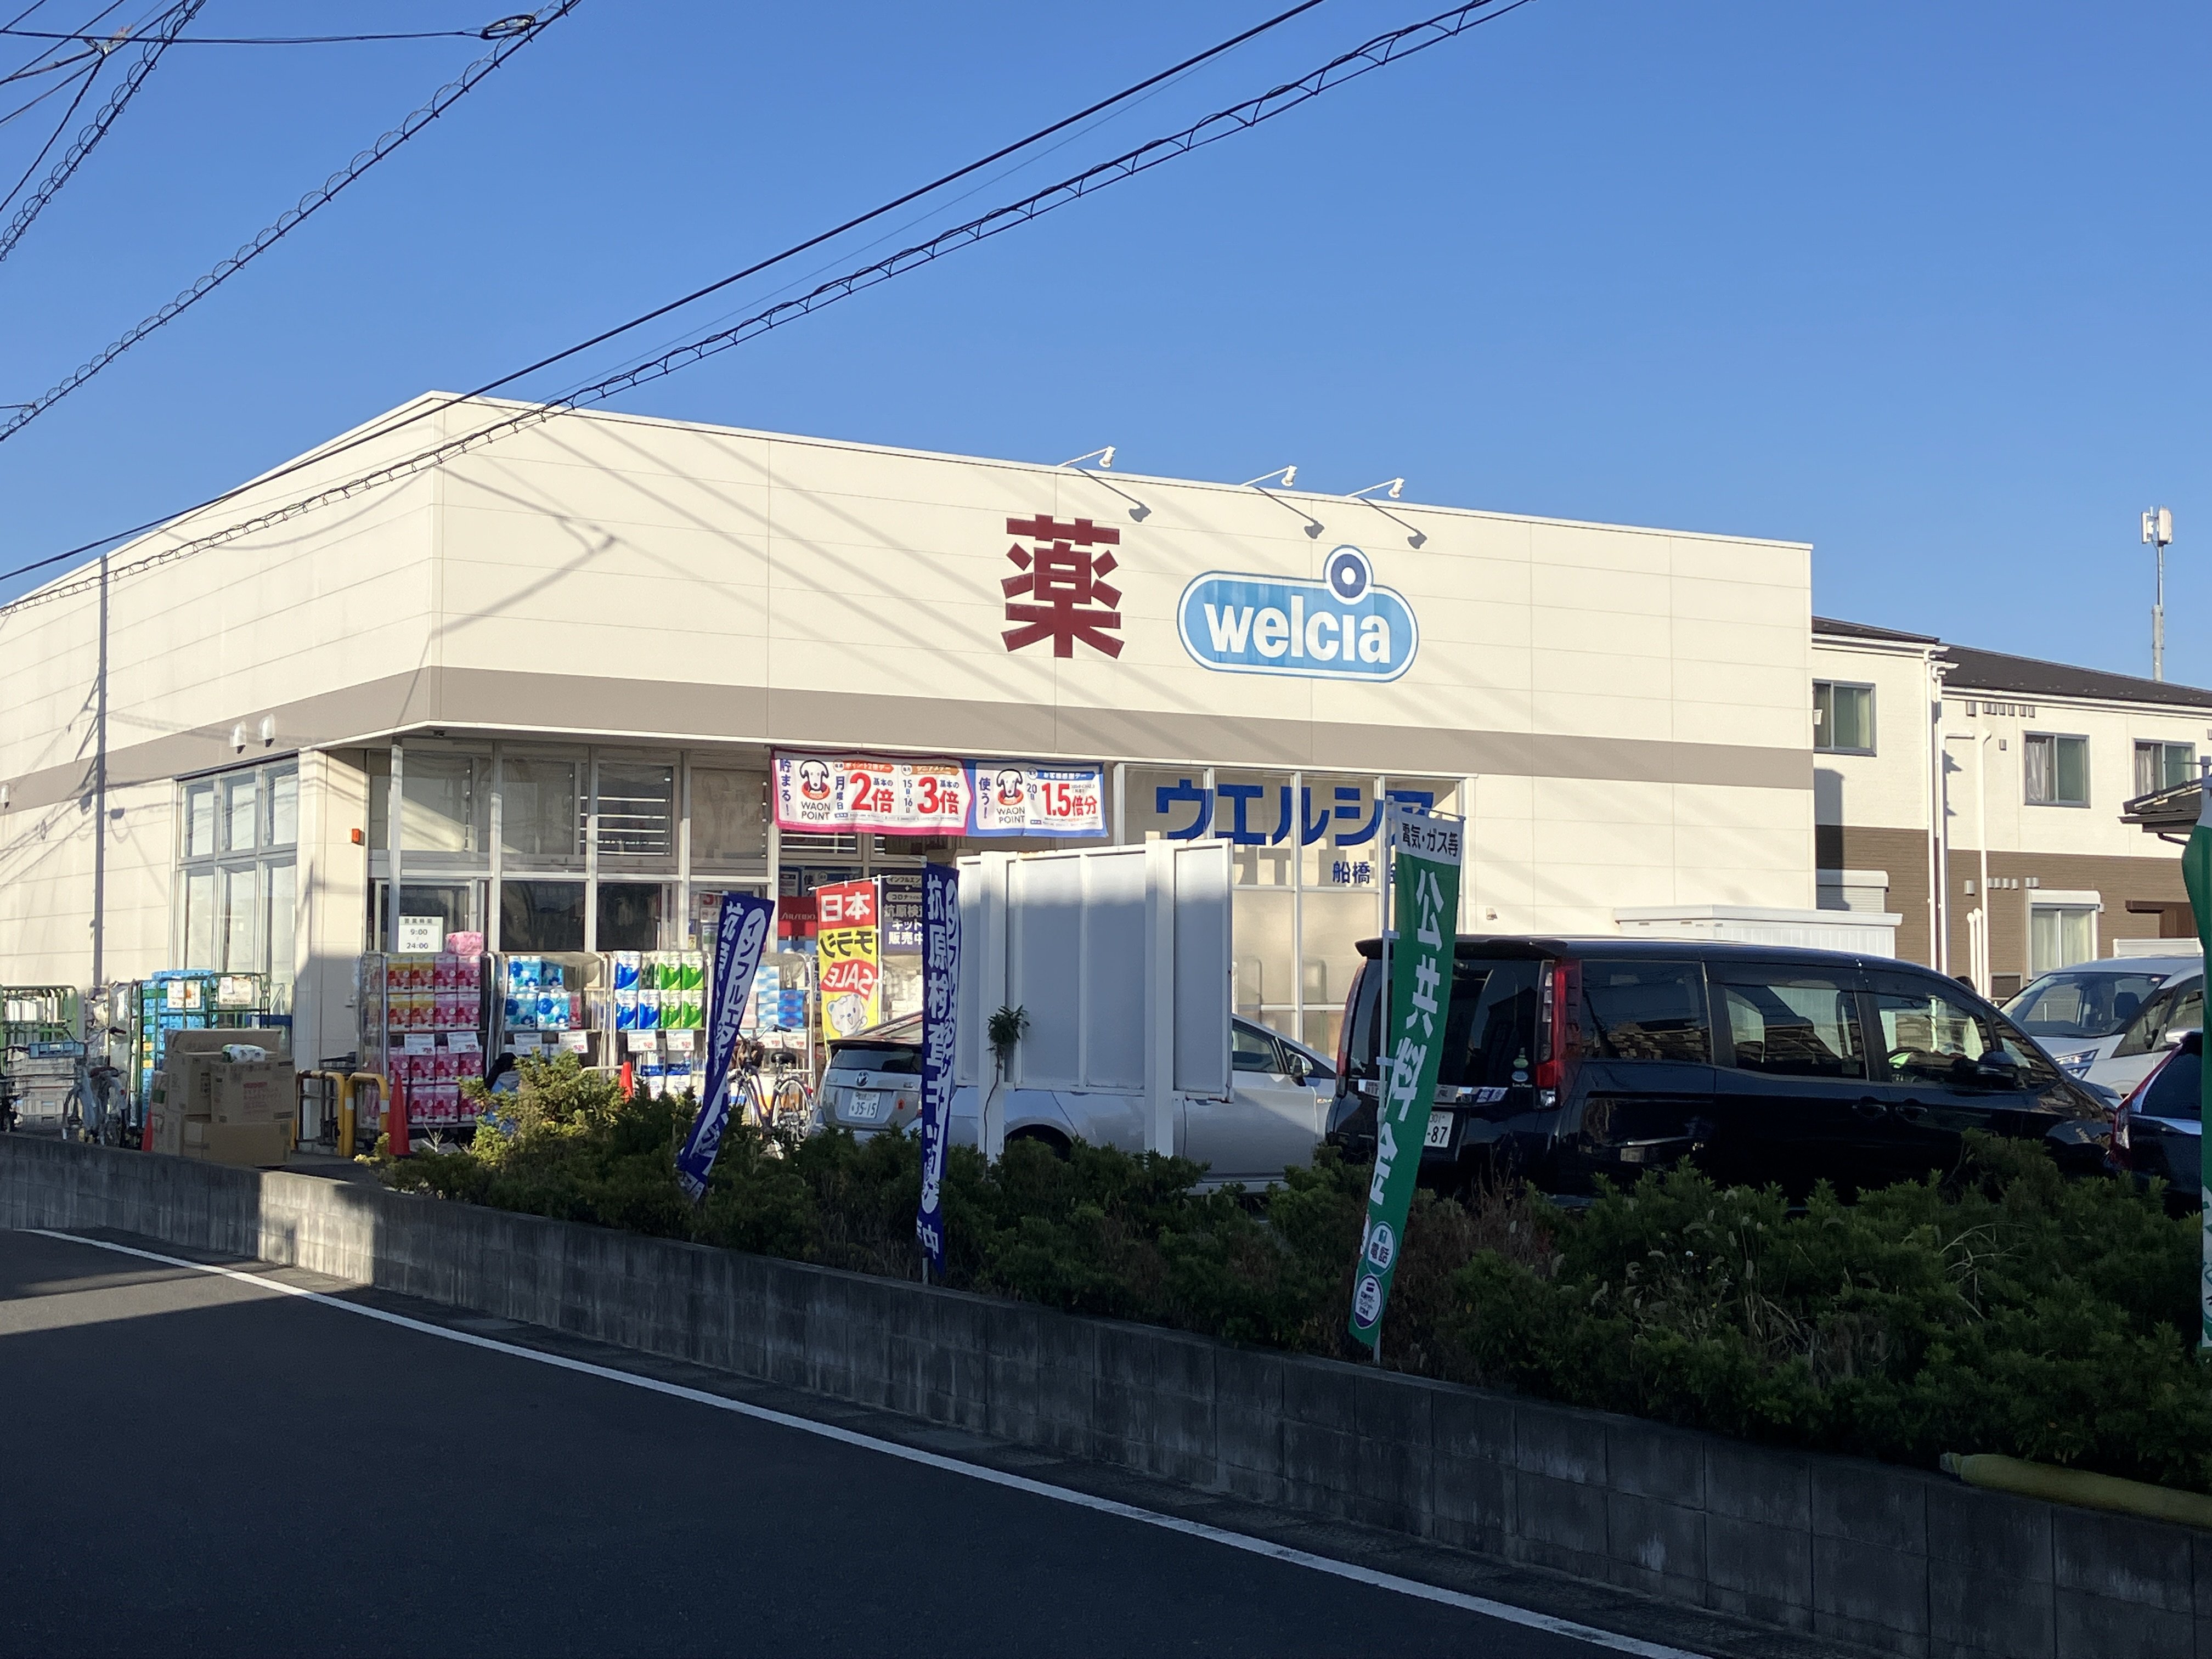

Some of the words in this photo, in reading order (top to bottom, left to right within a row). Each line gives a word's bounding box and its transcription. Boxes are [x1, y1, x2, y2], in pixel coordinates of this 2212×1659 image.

[1001, 514, 1125, 659] 薬
[1204, 552, 1391, 664] welcia
[940, 780, 960, 788] 基本の
[801, 802, 831, 810] WAON
[997, 806, 1025, 815] WAON
[802, 811, 830, 820] POINT
[998, 815, 1025, 823] POINT
[892, 919, 923, 931] キット
